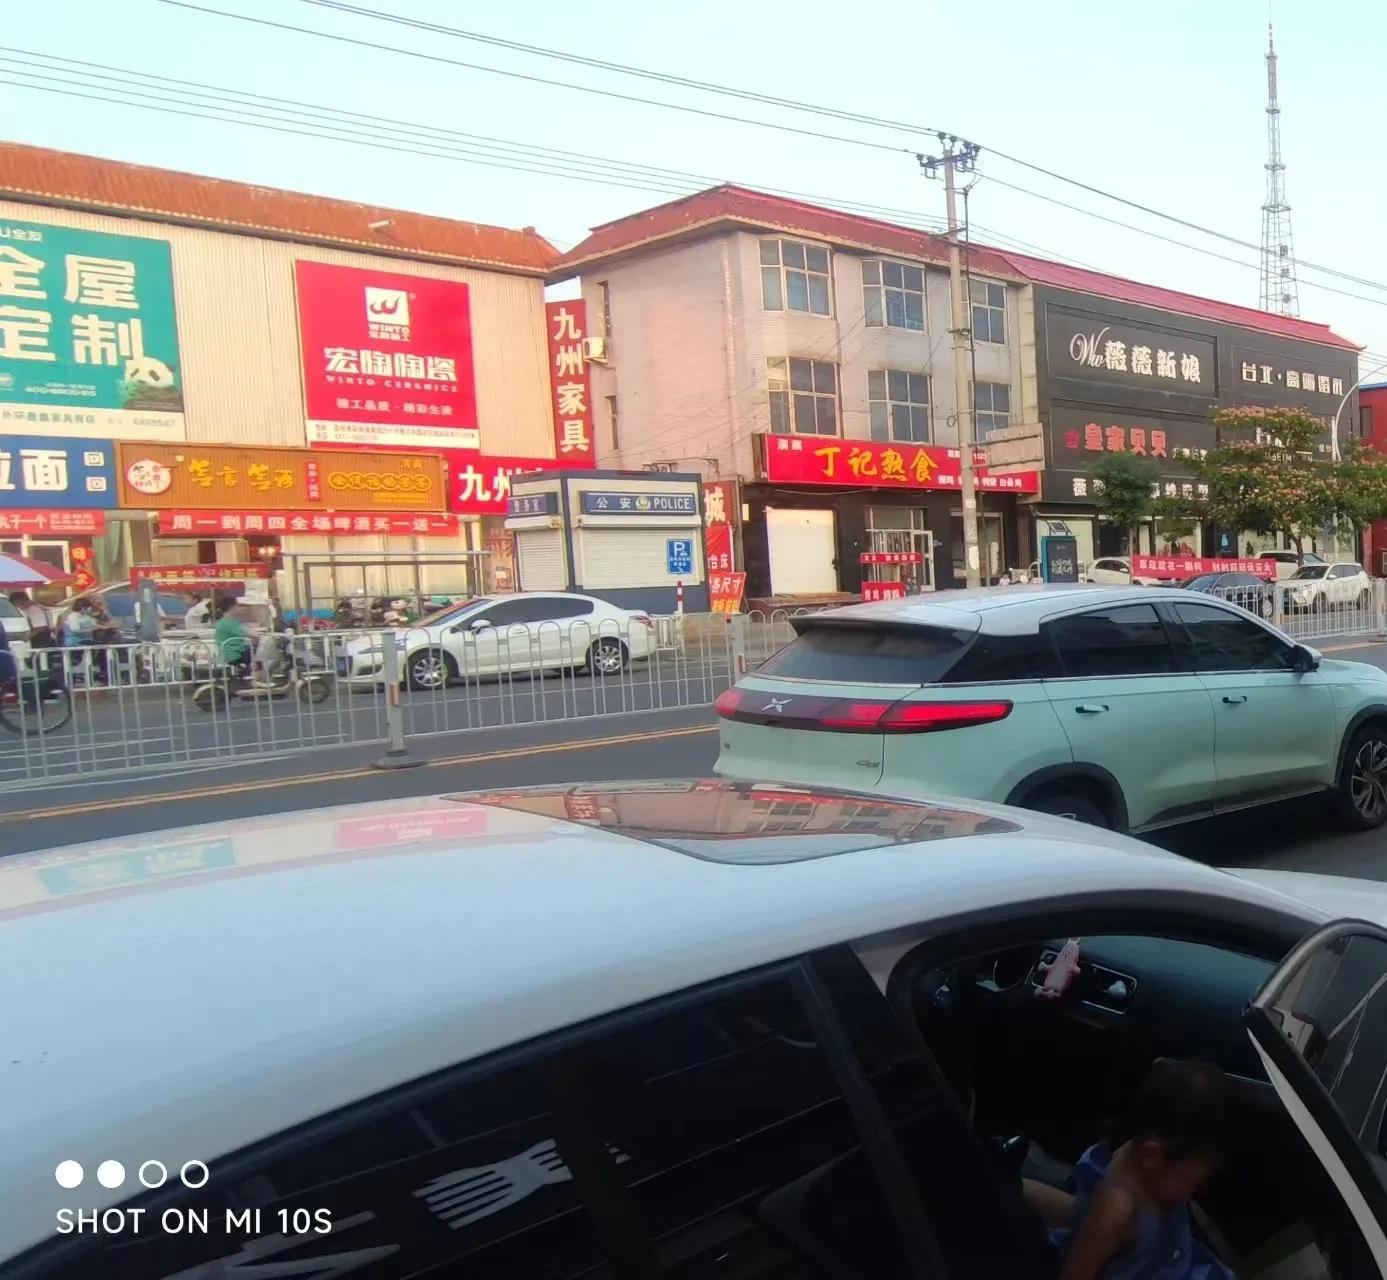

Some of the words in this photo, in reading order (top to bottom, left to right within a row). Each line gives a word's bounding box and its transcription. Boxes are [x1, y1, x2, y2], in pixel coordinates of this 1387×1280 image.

[323, 347, 458, 382] 宏陶陶瓷
[1105, 340, 1201, 383] 薇薇新娘
[325, 375, 377, 386] WINTO
[384, 380, 458, 393] CERAMICS
[552, 307, 590, 452] 九州家具
[1084, 423, 1168, 458] 皇家贝贝
[813, 447, 939, 482] 丁记熟食
[596, 497, 632, 509] 公安
[653, 497, 691, 510] POLICE
